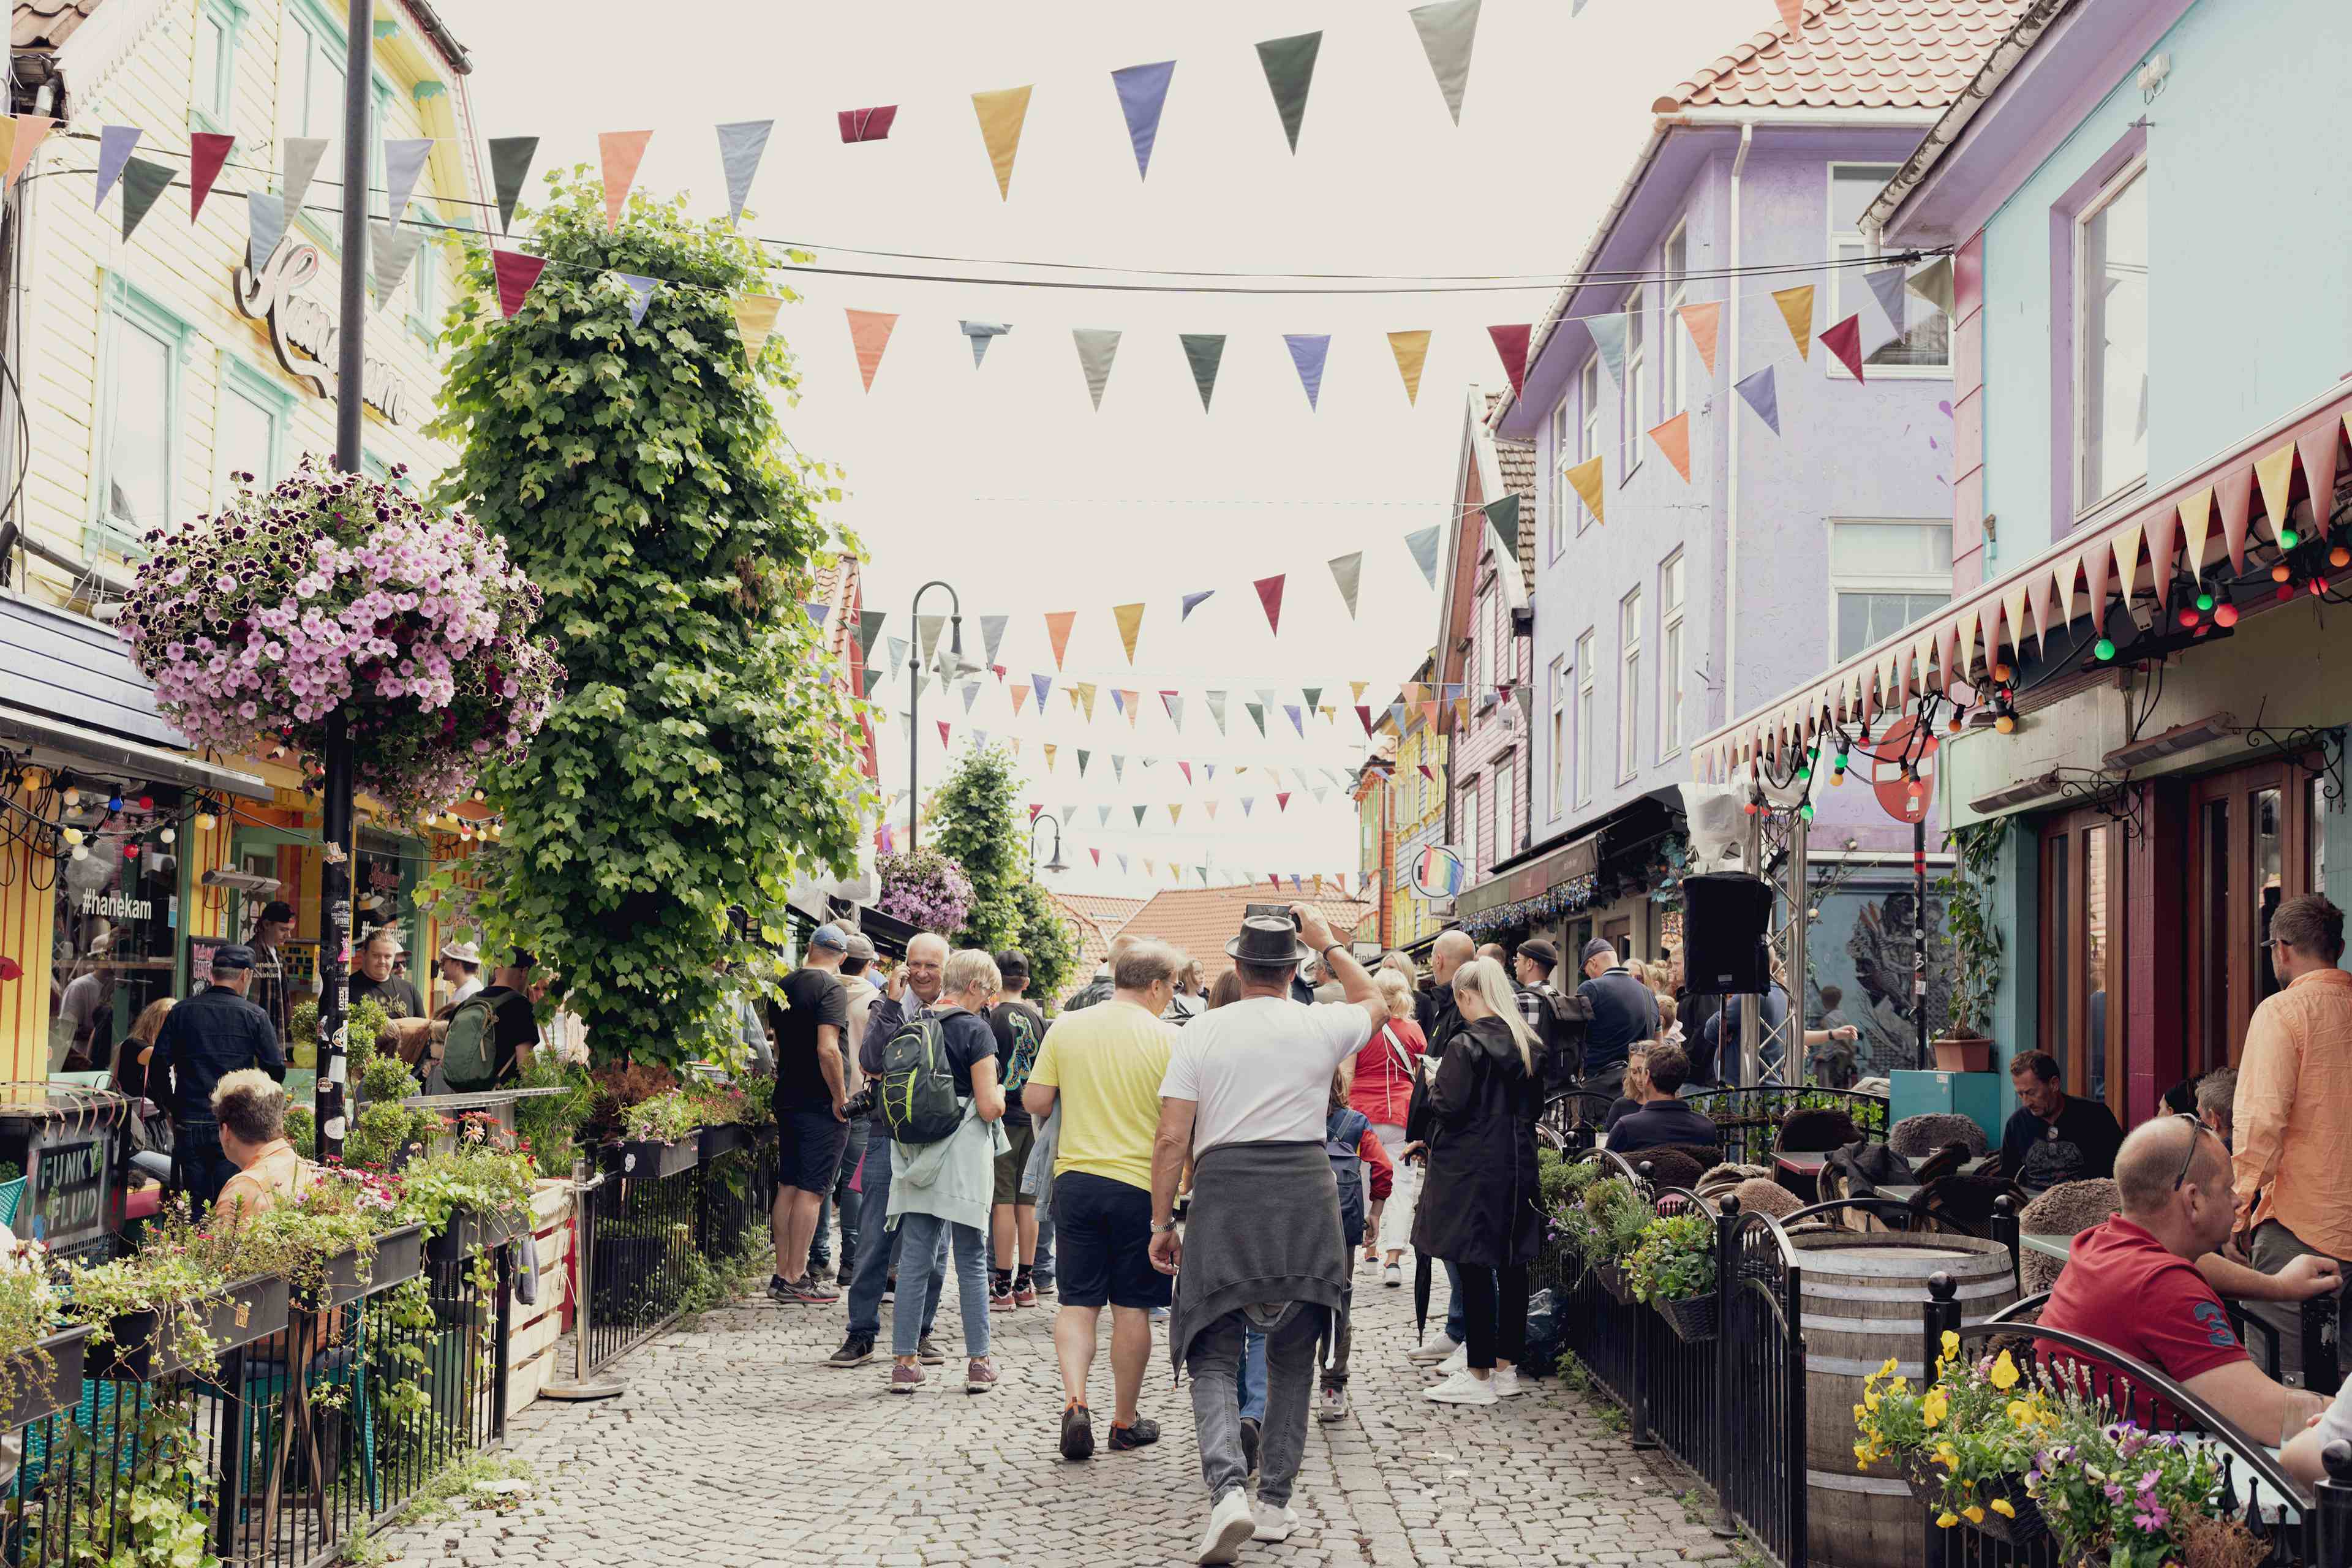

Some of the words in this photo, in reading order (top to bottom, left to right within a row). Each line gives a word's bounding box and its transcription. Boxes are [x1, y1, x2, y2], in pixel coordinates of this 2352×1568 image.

[233, 235, 407, 426] Haneam
[83, 888, 152, 920] #hanekam
[40, 1147, 100, 1191] FUNKY
[49, 1187, 98, 1231] FLUID
[2194, 1302, 2235, 1346] 3
